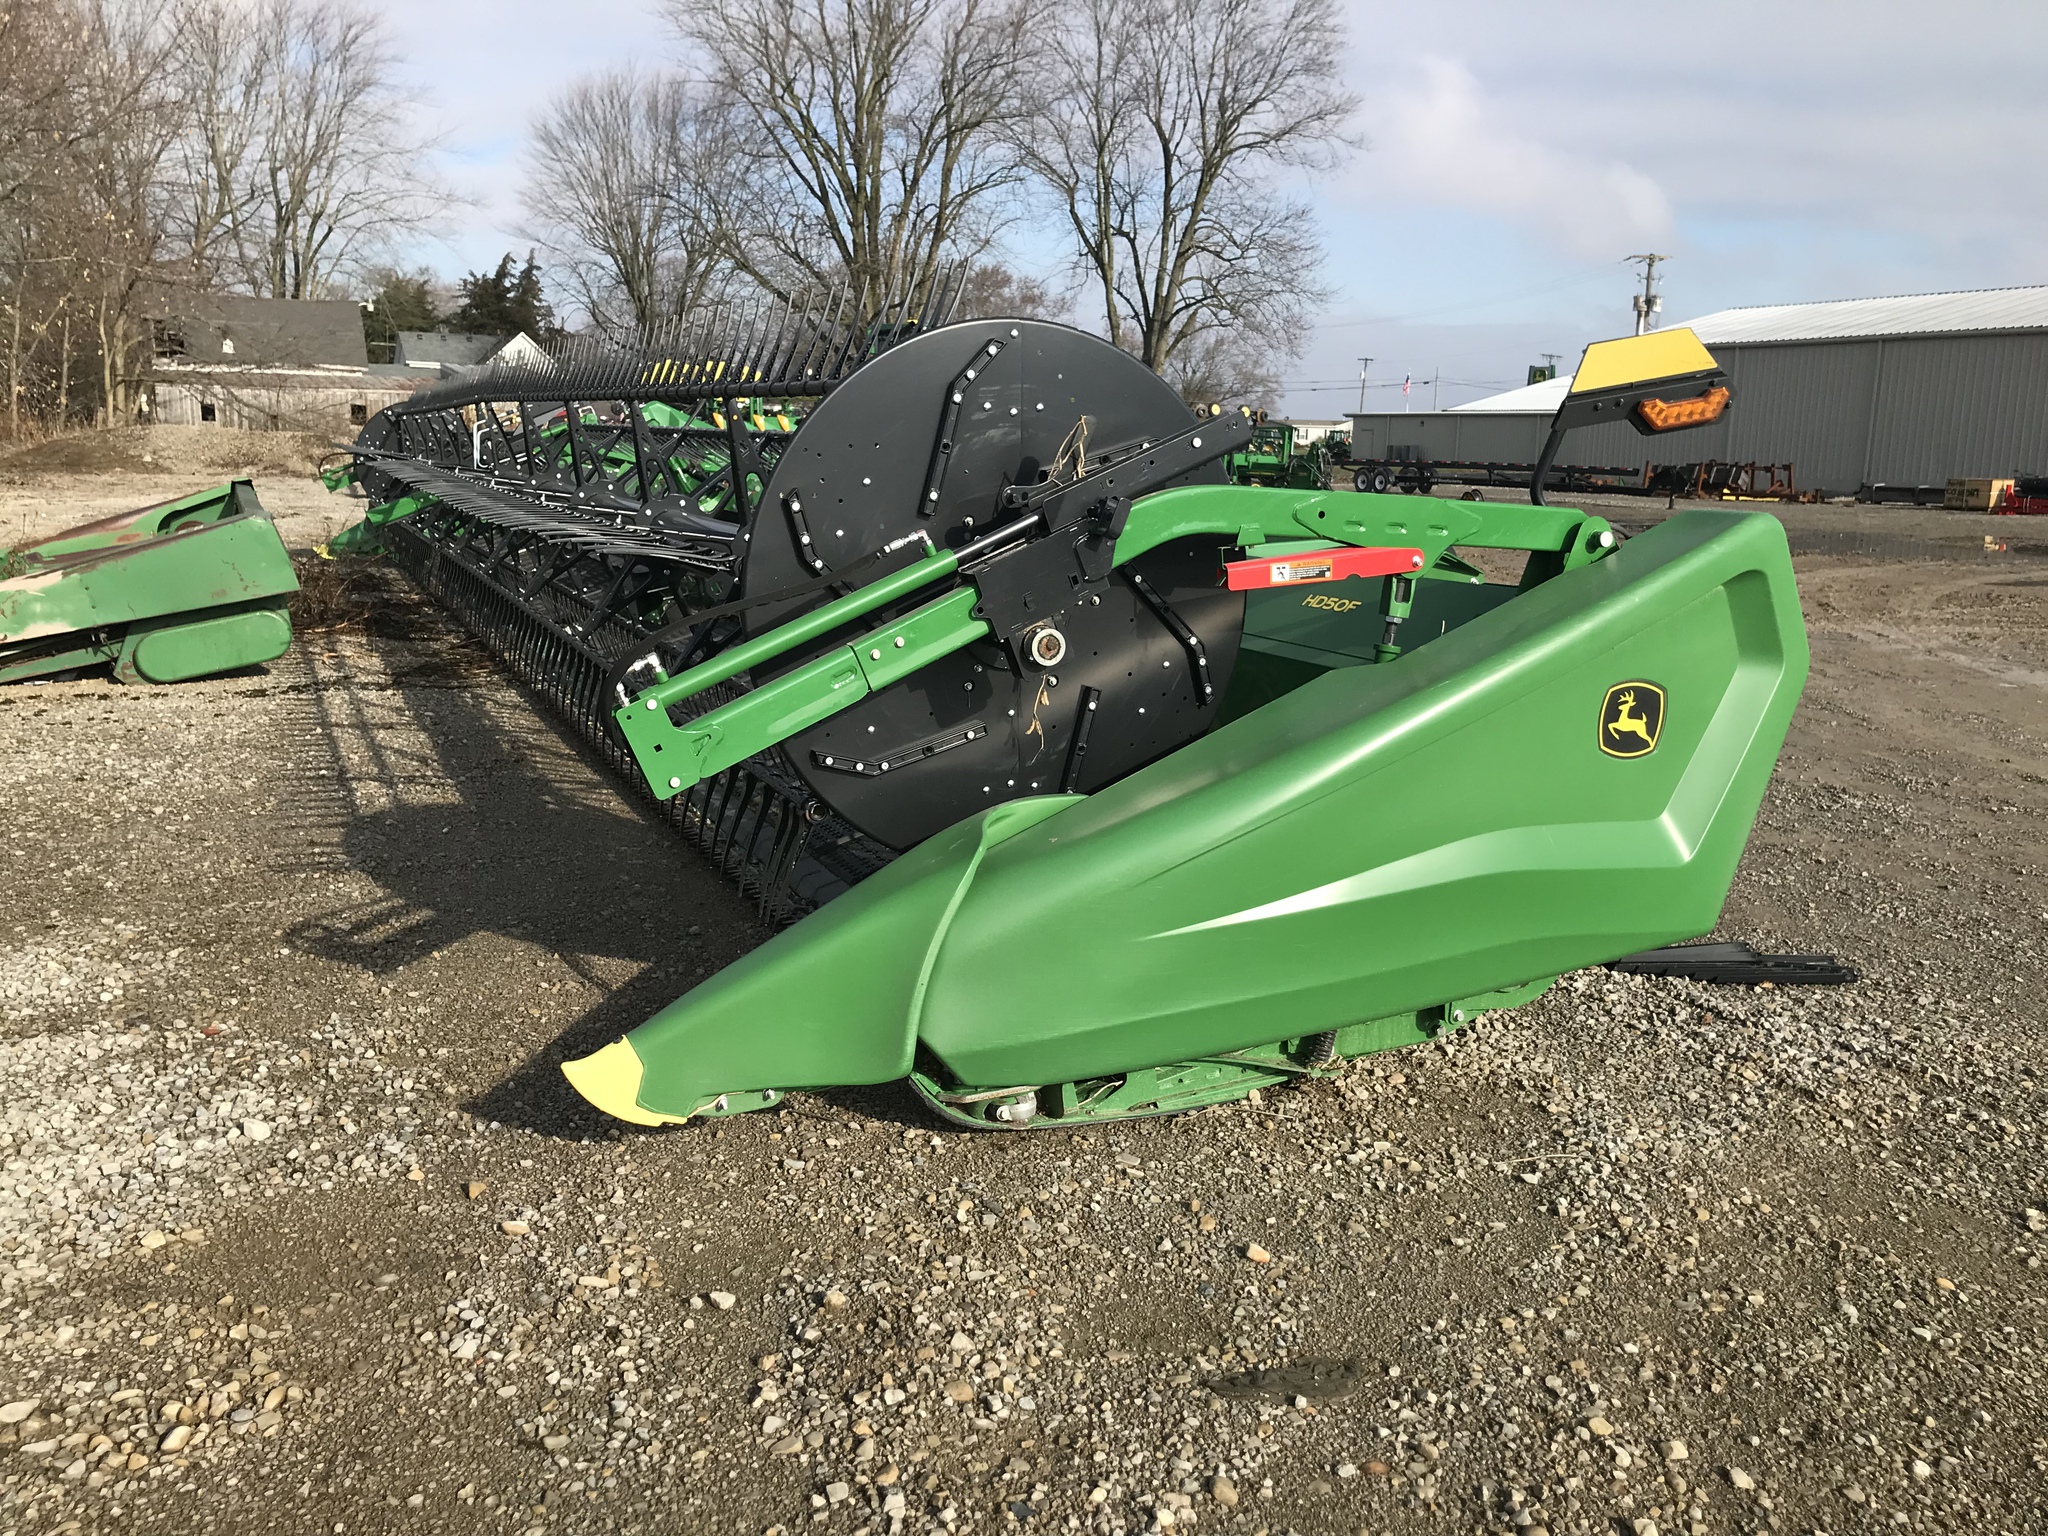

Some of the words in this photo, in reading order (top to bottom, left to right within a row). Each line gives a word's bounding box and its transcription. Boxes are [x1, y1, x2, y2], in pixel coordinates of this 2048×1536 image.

[1184, 441, 1192, 453] 3
[1140, 461, 1148, 473] 2
[1301, 594, 1363, 613] HD50F
